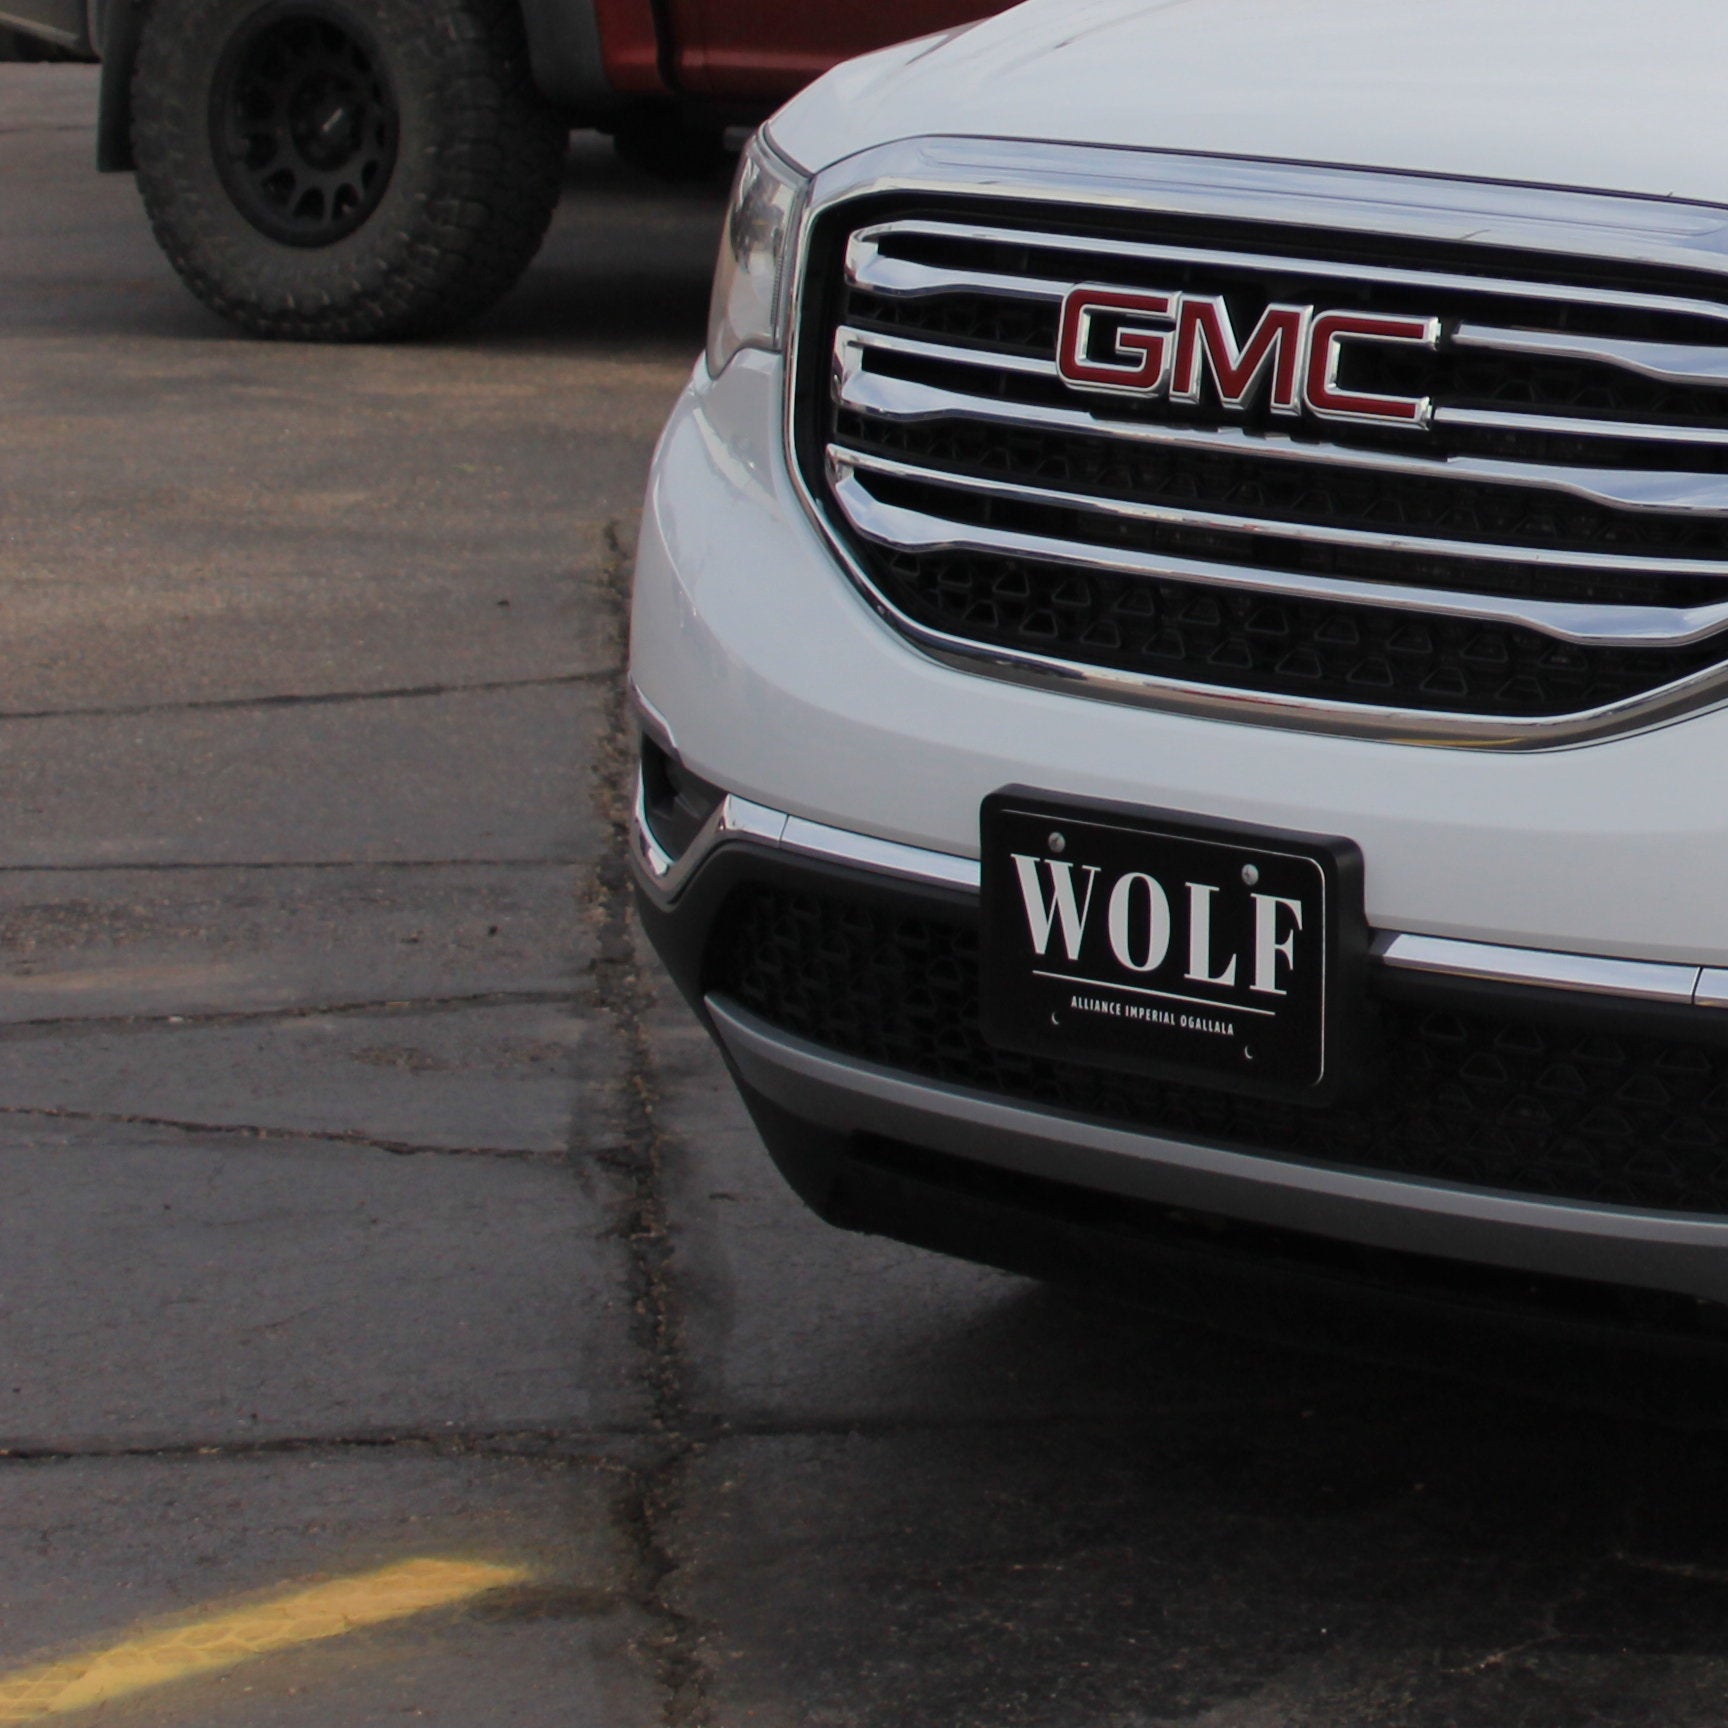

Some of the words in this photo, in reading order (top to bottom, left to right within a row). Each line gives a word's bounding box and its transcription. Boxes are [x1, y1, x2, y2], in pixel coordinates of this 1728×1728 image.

[1056, 282, 1441, 430] GMC
[1010, 852, 1303, 996] WOLF
[1070, 995, 1122, 1016] ALLIANCE
[1125, 1004, 1176, 1026] IMPERIAL
[1179, 1014, 1235, 1036] OGALLALA
